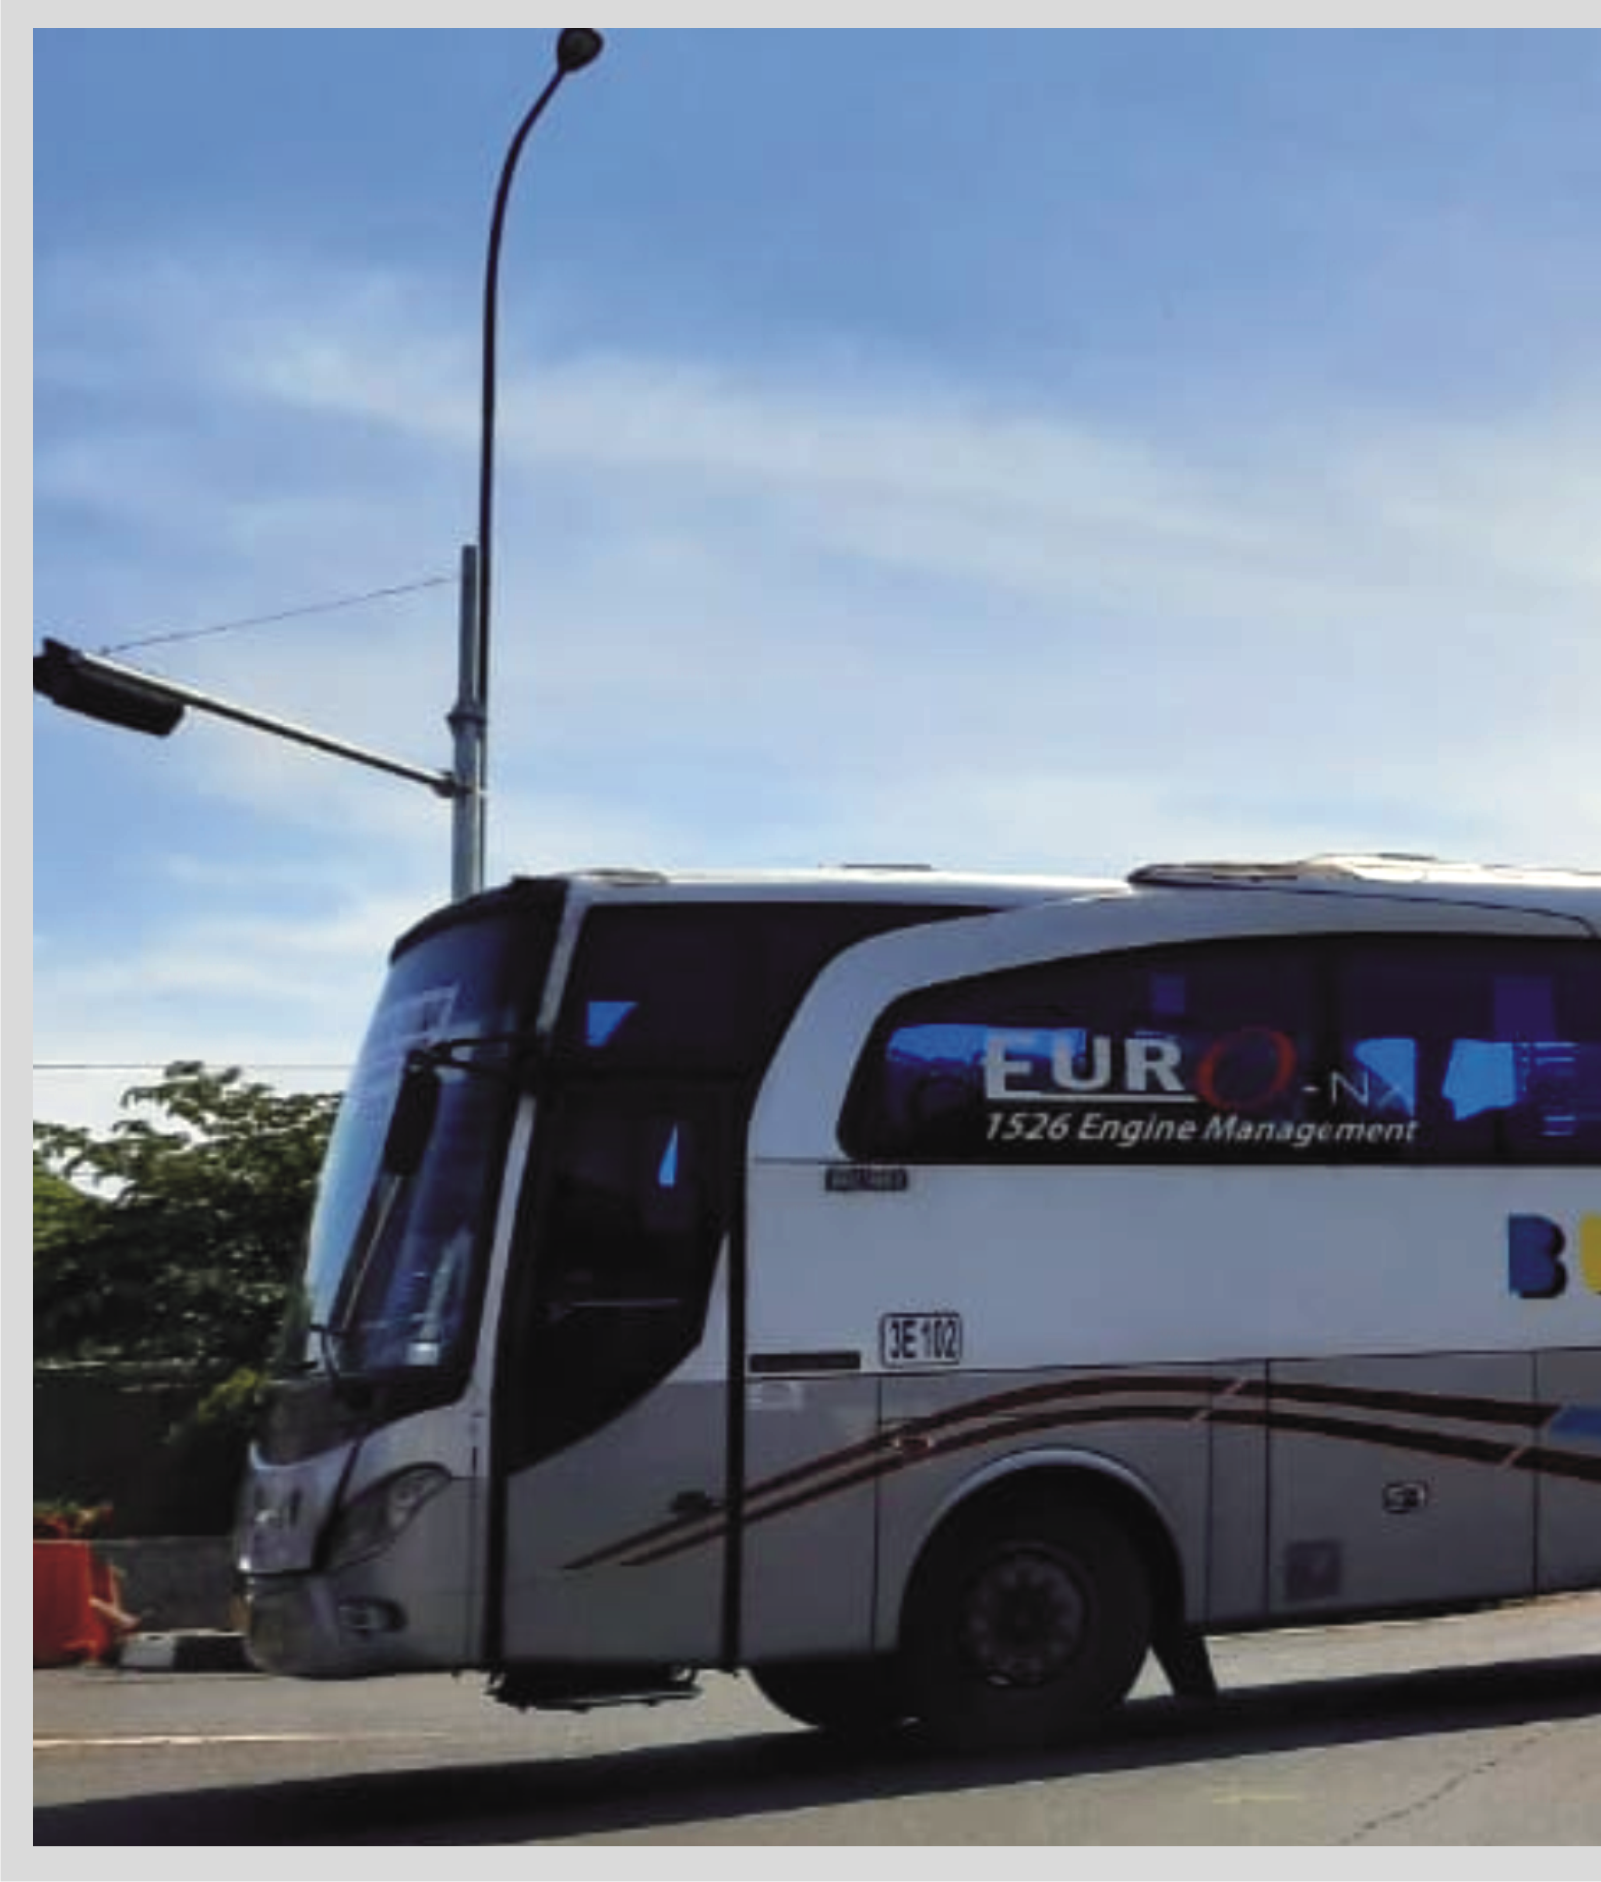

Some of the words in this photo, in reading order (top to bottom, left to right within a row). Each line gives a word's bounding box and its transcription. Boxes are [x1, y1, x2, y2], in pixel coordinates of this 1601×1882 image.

[985, 1113, 1070, 1141] 1526
[1078, 1113, 1198, 1148] Engine
[1203, 1113, 1419, 1148] Management
